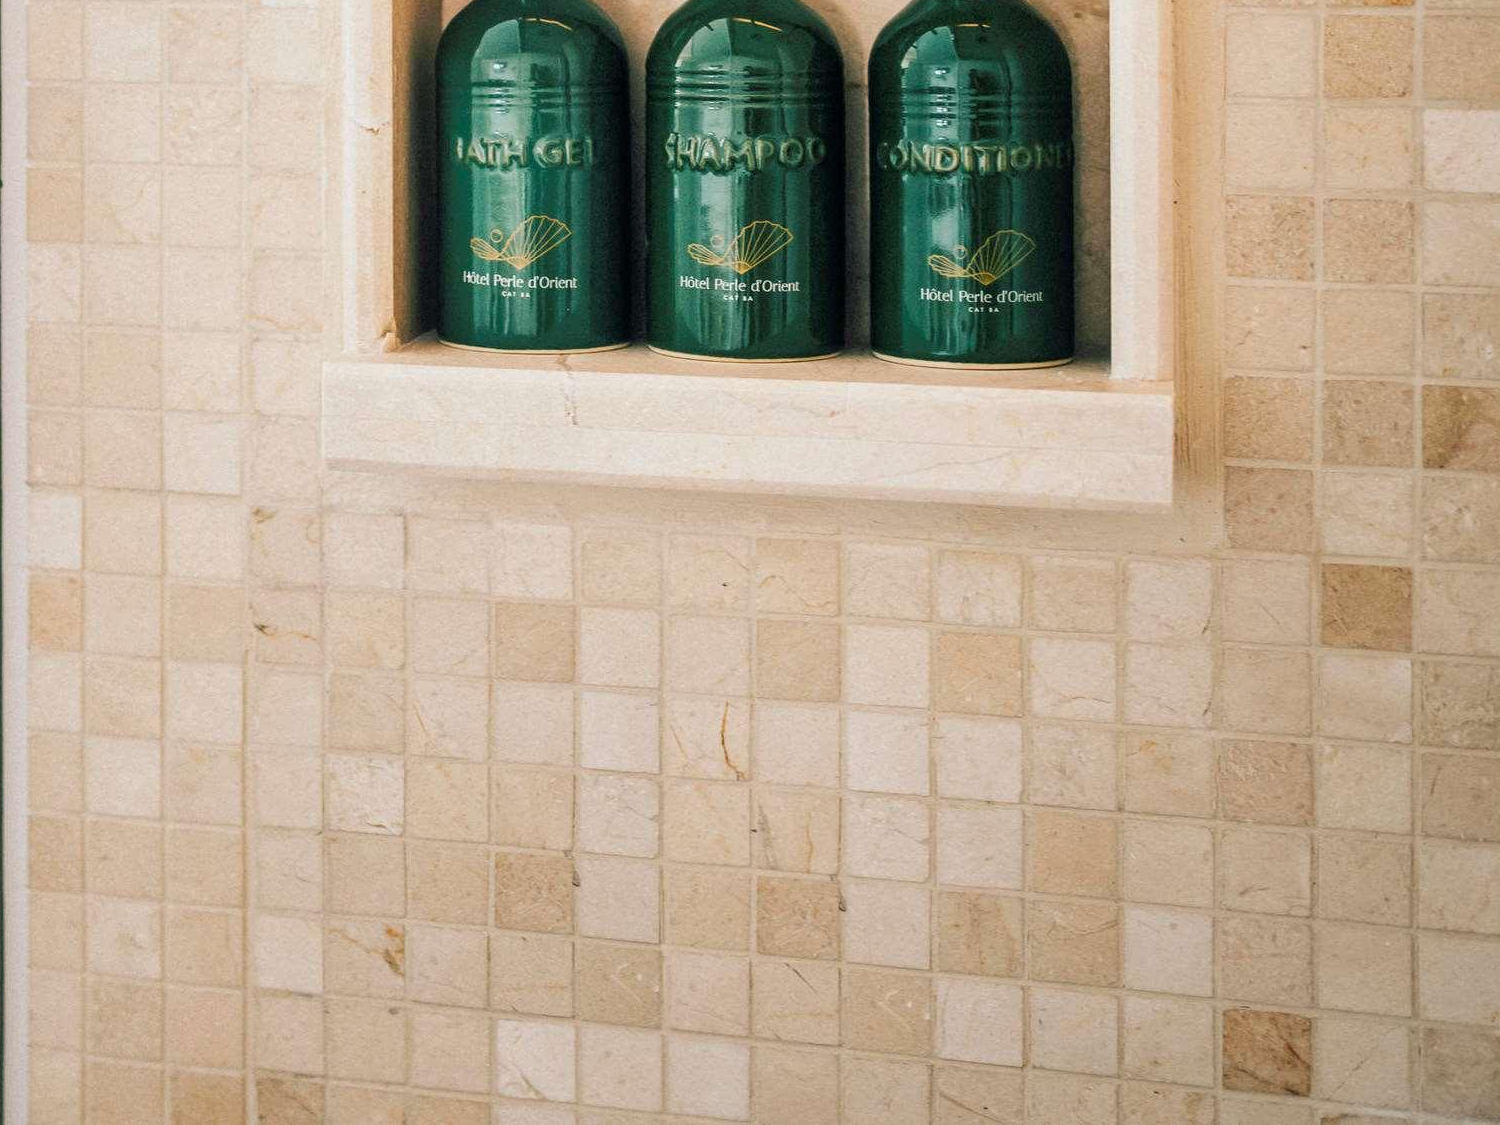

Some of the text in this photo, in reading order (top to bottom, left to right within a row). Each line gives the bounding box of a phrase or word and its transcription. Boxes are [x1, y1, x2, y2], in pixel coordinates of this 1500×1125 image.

[463, 270, 578, 290] Hôtel Perle d'Orient
[680, 275, 800, 293] Hôtel Perle d'Orient
[920, 287, 1044, 304] Hôtel Perle d'Orient
